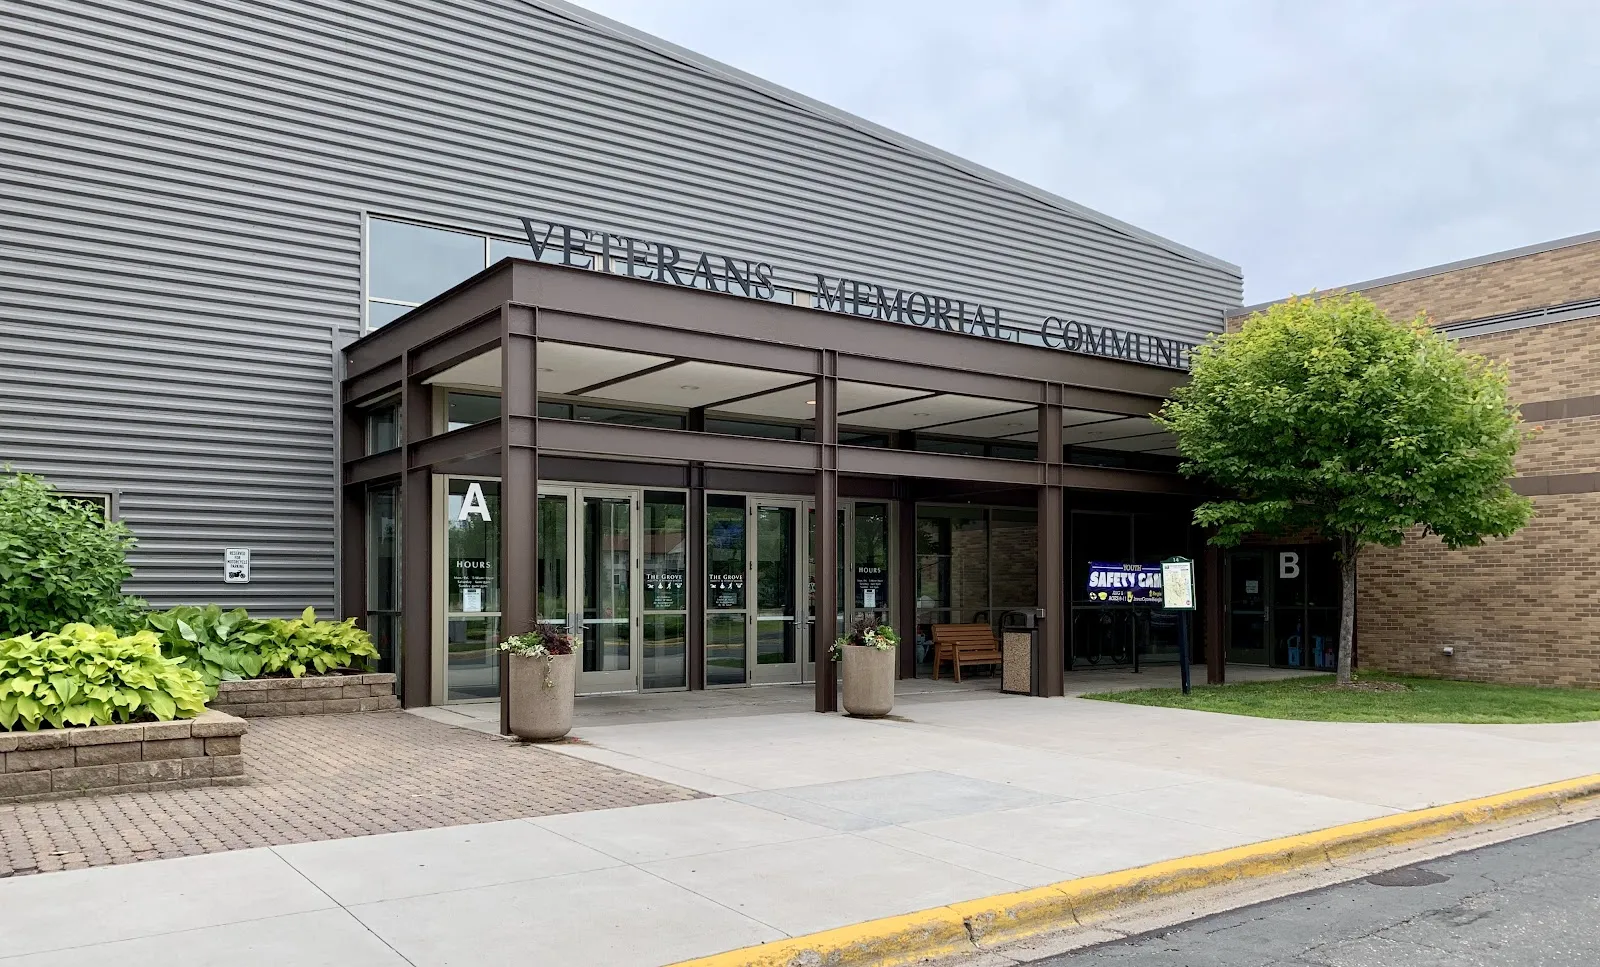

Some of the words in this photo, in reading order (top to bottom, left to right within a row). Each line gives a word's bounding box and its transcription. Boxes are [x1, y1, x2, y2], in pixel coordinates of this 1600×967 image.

[517, 217, 774, 300] VETERANS
[814, 273, 1012, 340] MEMORIAL
[458, 482, 492, 521] A
[456, 560, 491, 569] HOURS
[858, 566, 881, 574] HOURS
[1280, 551, 1300, 579] B
[1089, 571, 1136, 588] SAFETY
